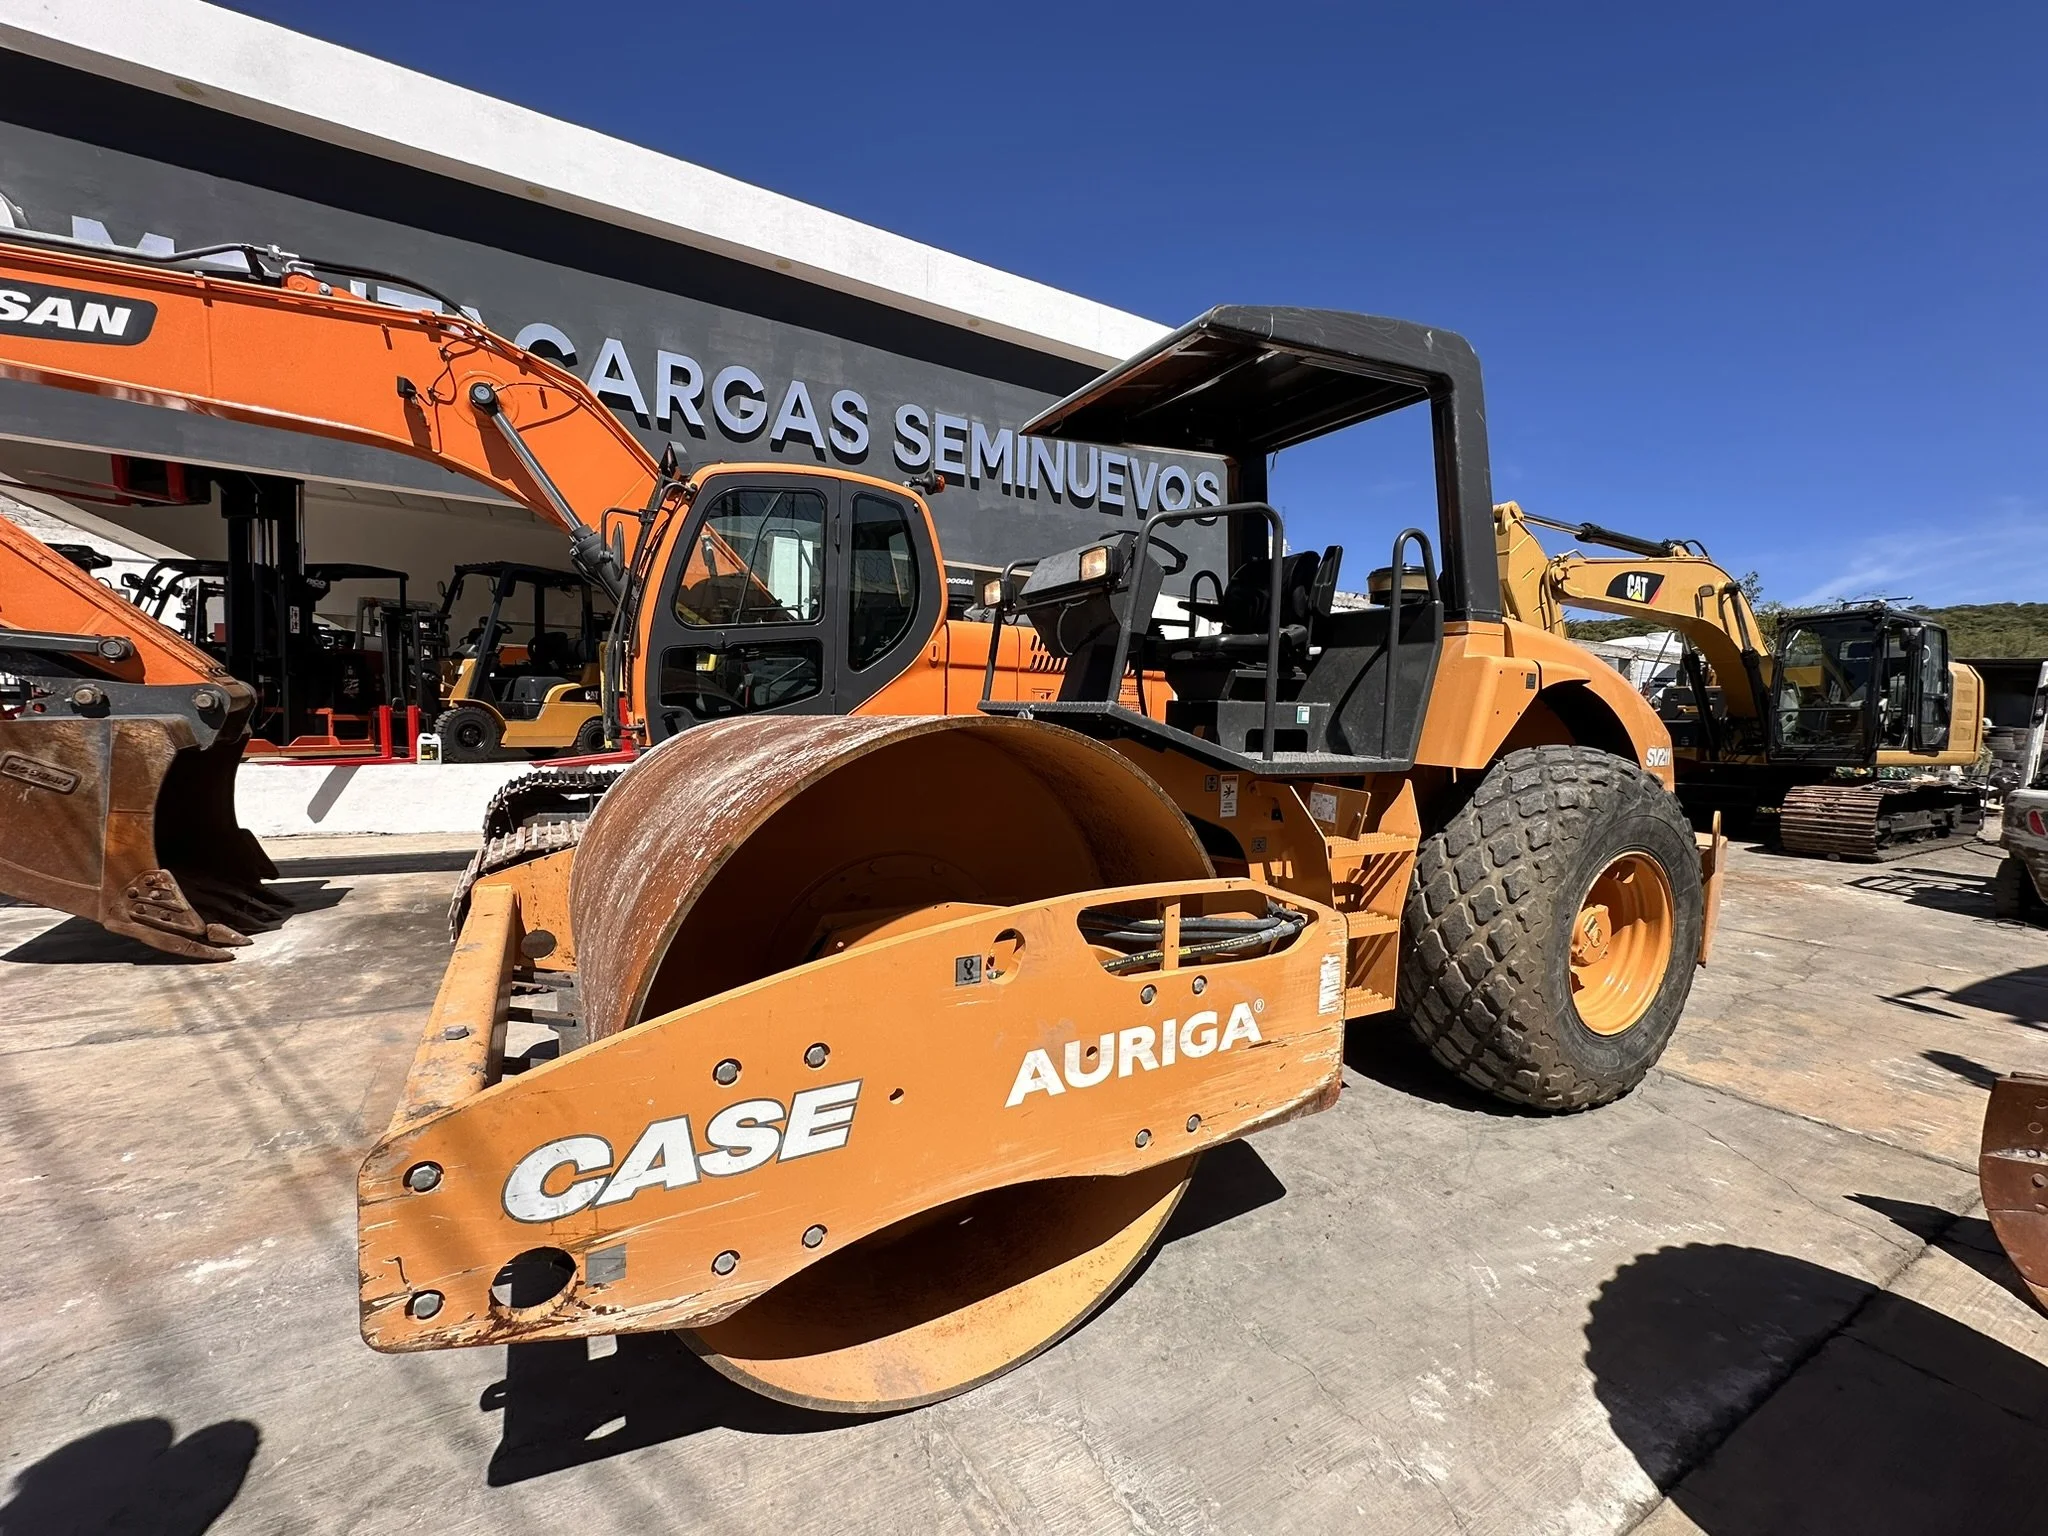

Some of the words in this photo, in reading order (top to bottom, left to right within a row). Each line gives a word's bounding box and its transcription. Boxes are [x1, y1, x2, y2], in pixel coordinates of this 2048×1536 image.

[893, 403, 1220, 521] SEMINUEVOS
[1627, 574, 1648, 602] CAT
[585, 690, 598, 700] CAT
[501, 1078, 863, 1224] CASE
